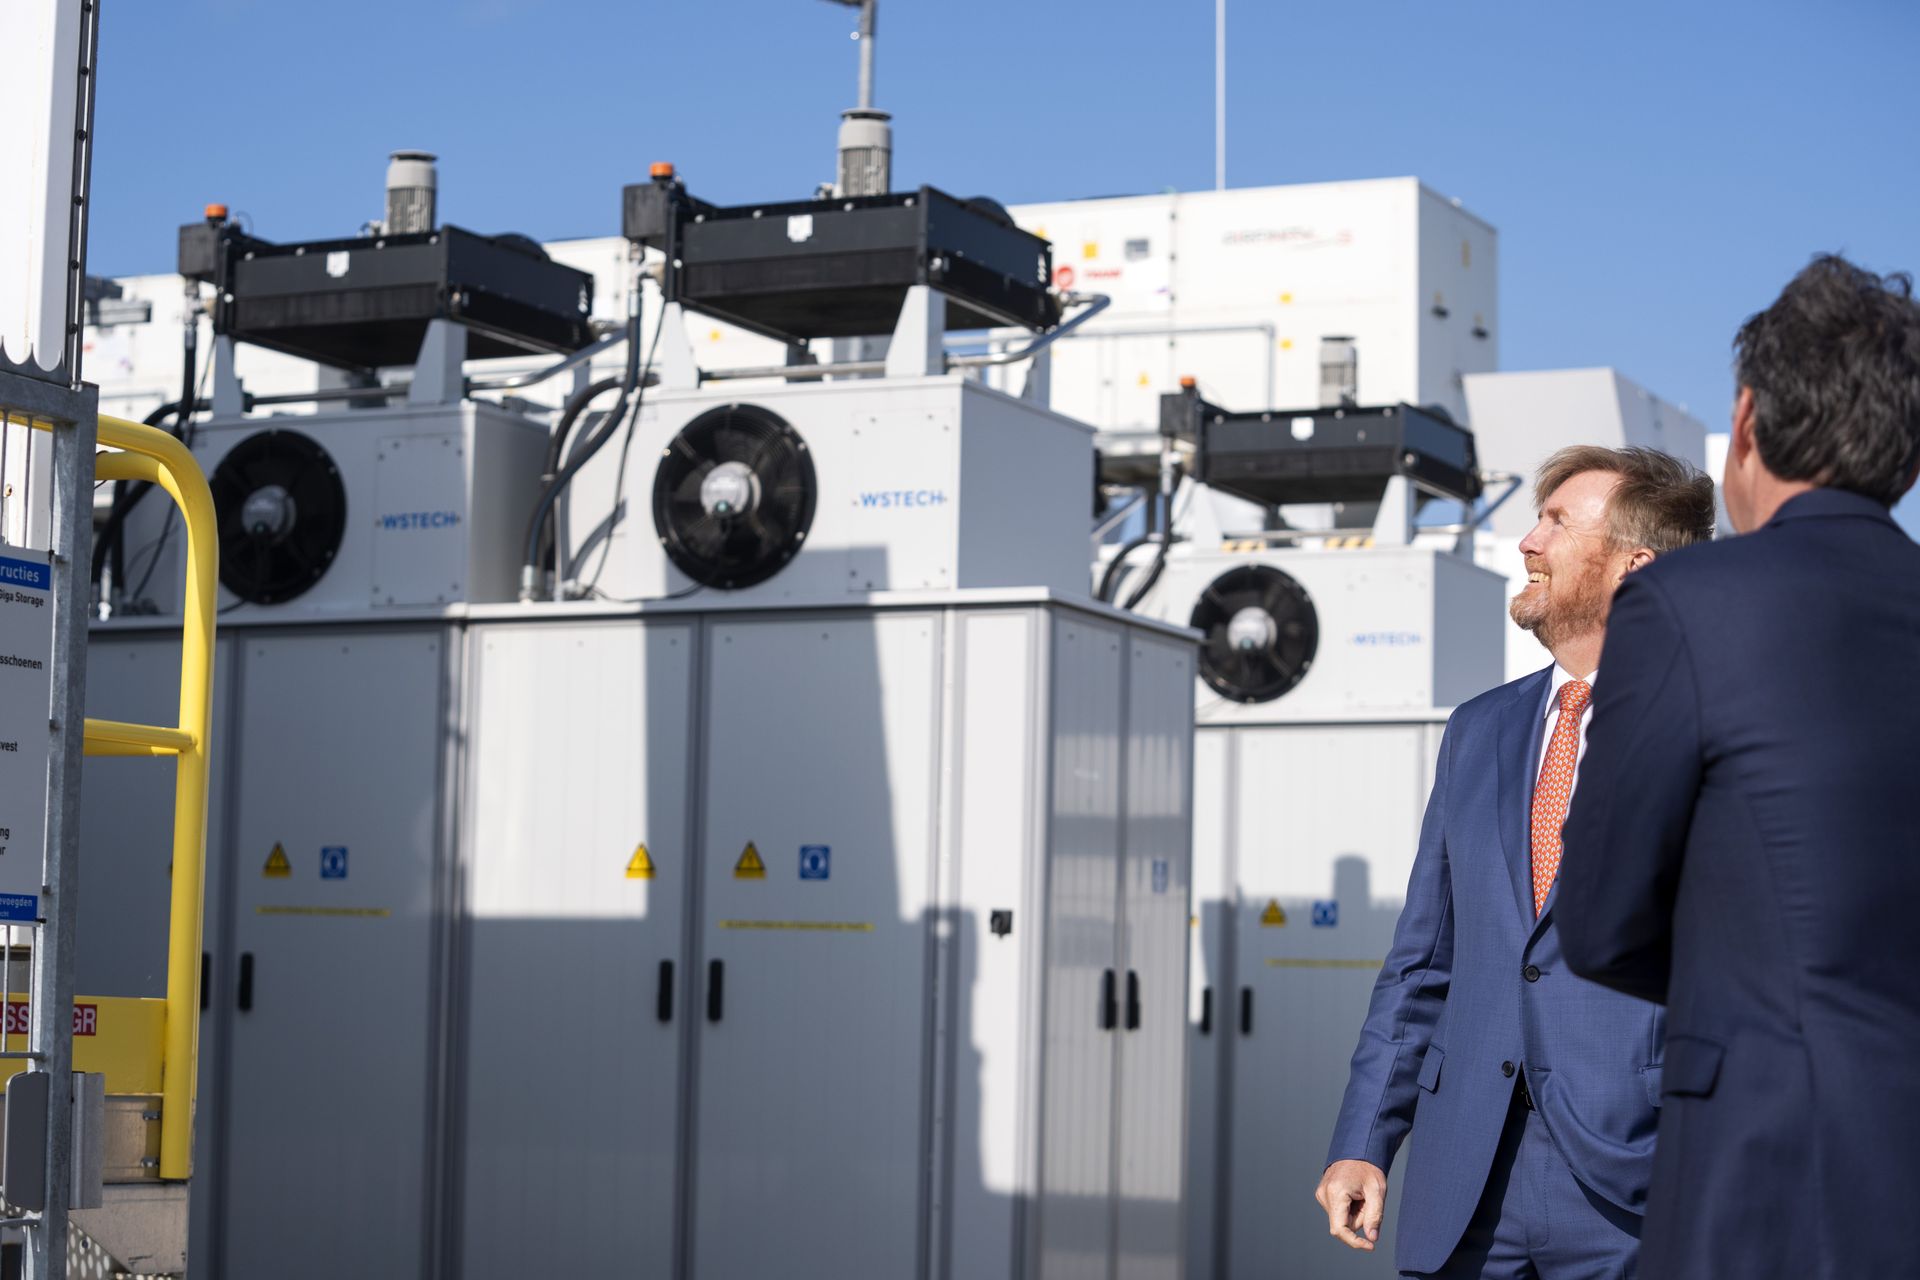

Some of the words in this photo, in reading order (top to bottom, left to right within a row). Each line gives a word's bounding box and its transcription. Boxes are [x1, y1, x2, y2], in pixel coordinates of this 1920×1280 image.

[860, 490, 944, 508] WSTECH
[383, 511, 457, 529] WSTECH
[15, 591, 44, 608] Storage
[0, 740, 18, 752] vest
